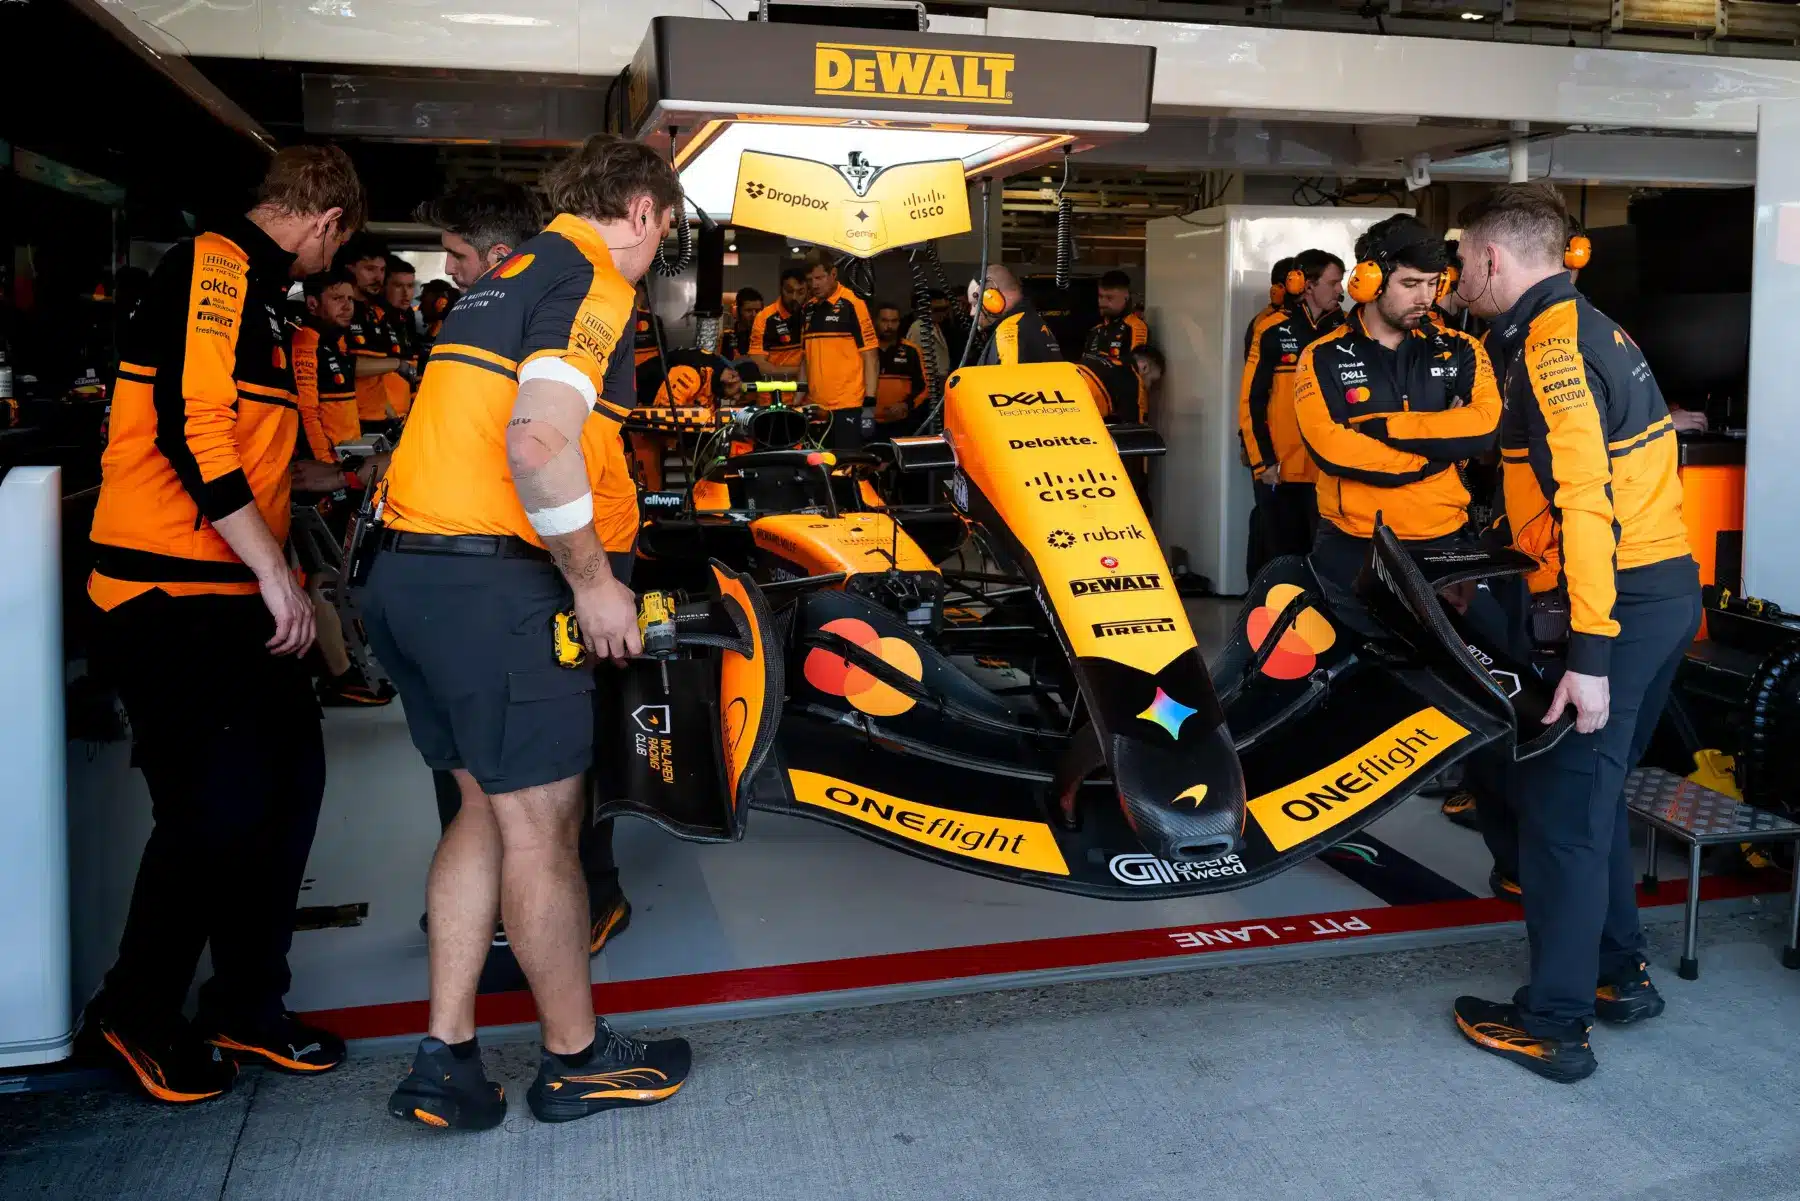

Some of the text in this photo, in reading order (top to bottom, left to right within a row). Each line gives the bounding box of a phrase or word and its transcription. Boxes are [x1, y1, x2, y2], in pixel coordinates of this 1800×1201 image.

[767, 187, 829, 212] Dropbox
[910, 205, 944, 220] CISCO
[846, 228, 878, 240] Gemini
[206, 255, 240, 271] Hilton
[201, 278, 238, 299] okta
[212, 302, 236, 314] MOUNTAIN
[197, 311, 234, 327] PIRELLI
[585, 316, 612, 342] Hilton
[577, 332, 605, 366] okta
[1531, 337, 1571, 352] FxPro
[1535, 353, 1575, 370] workday
[1341, 370, 1367, 381] DELL
[1548, 365, 1578, 377] Dropbox
[1543, 377, 1581, 394] ECOLAB
[988, 390, 1075, 408] DELL
[996, 405, 1080, 417] Technologies
[1009, 436, 1097, 450] Deloitte.
[644, 495, 680, 507] allwyn
[1039, 486, 1116, 502] CISCO
[1082, 524, 1146, 543] rubrik
[1091, 617, 1176, 638] PIRELLI
[1467, 645, 1493, 666] CLUB
[635, 733, 647, 757] CLUB
[647, 736, 661, 770] RACING
[1281, 727, 1439, 822] ONEflight
[825, 787, 1028, 854] ONEflight
[1177, 859, 1247, 882] Tweed
[1308, 916, 1372, 935] PIT
[1168, 924, 1280, 948] LANE
